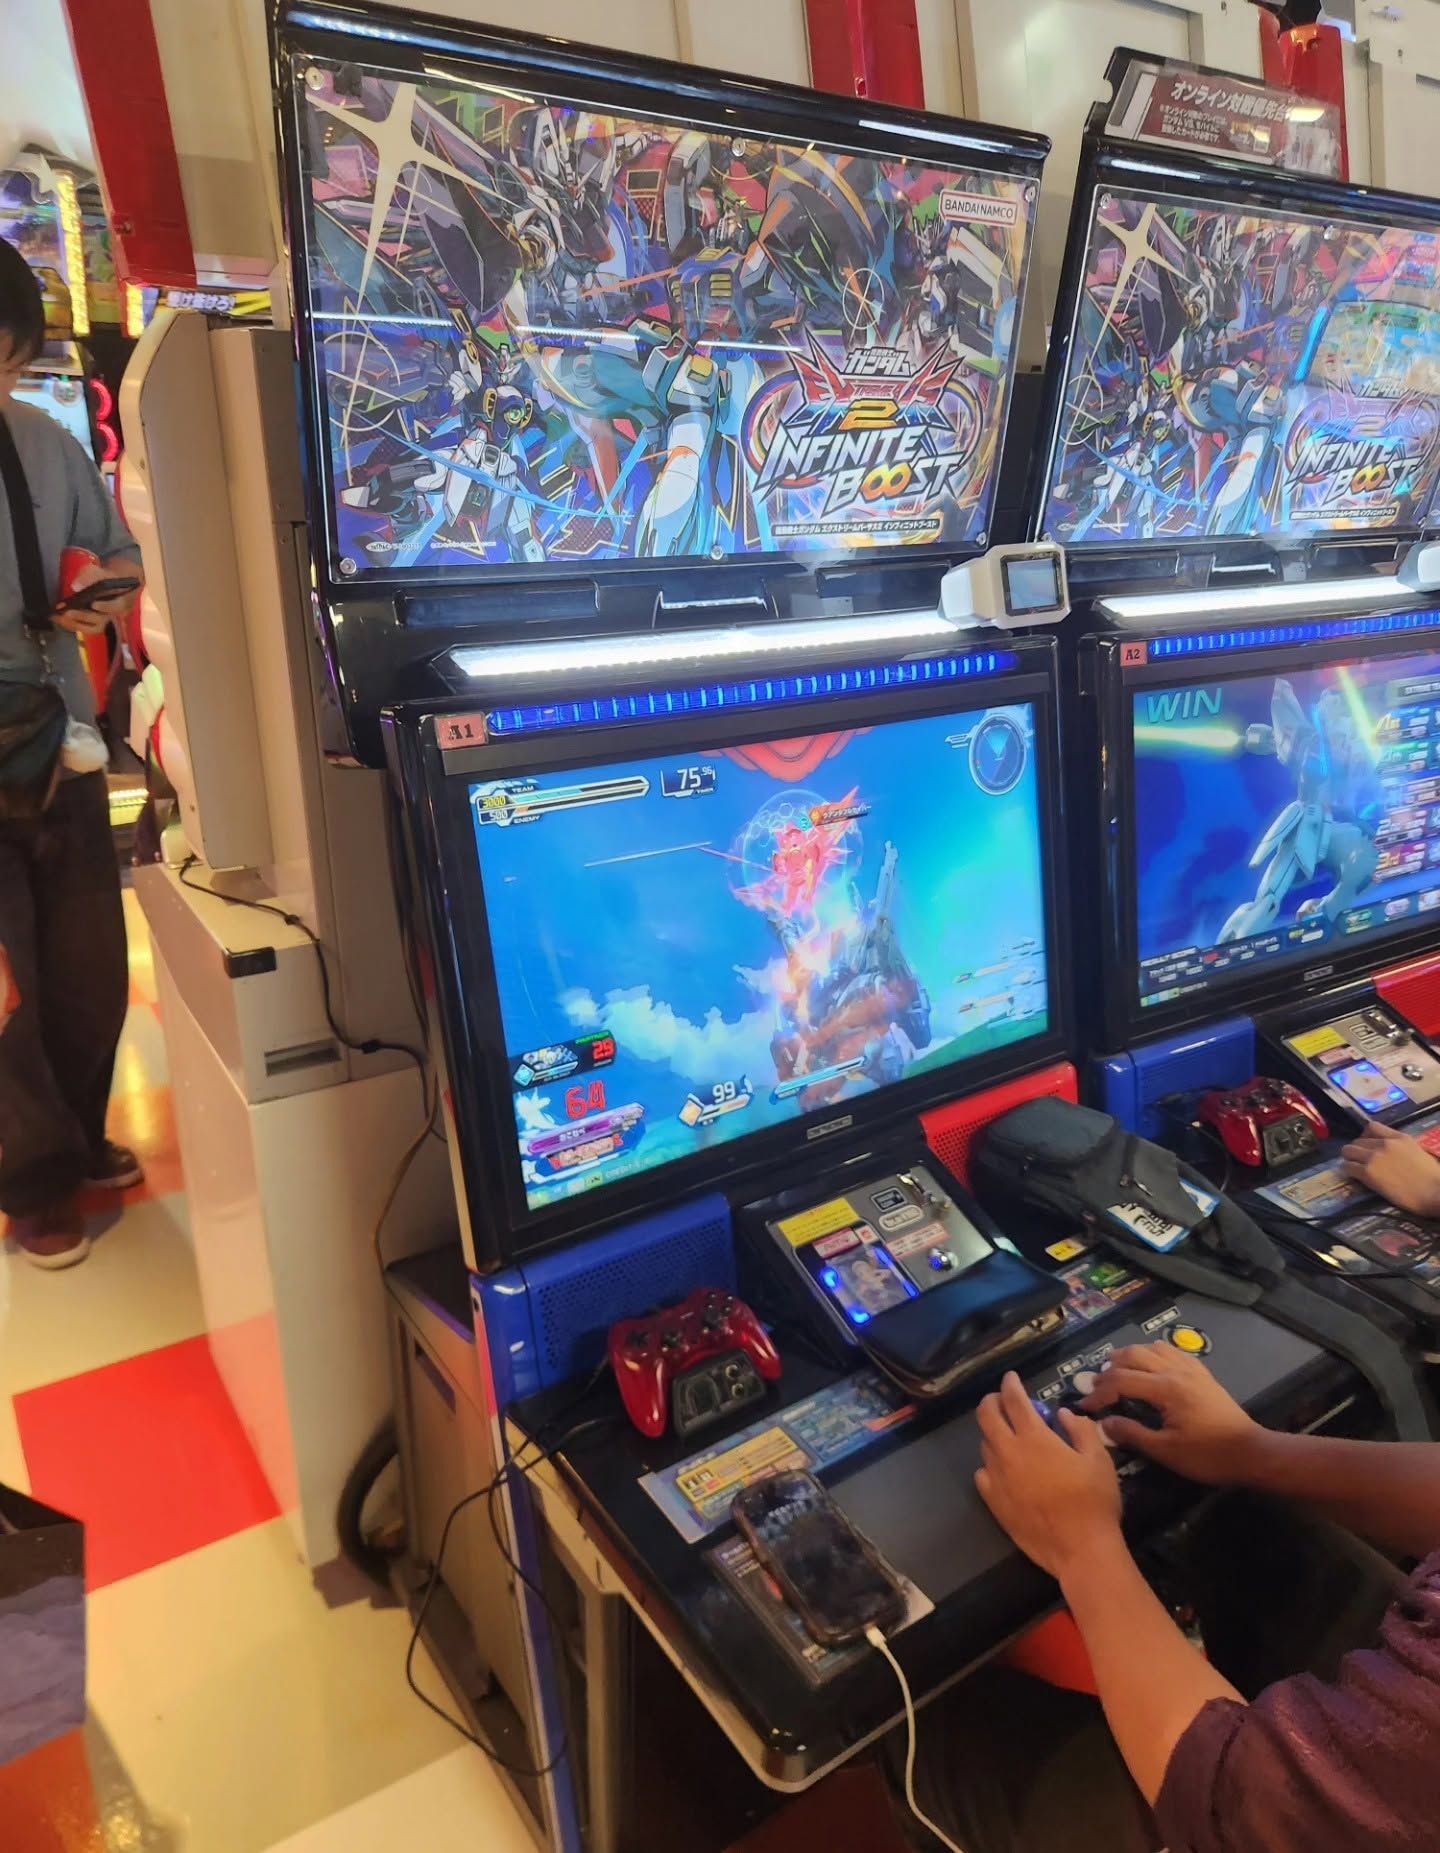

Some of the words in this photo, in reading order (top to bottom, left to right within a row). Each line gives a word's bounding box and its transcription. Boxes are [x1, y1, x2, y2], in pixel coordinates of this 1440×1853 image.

[944, 198, 980, 214] BANDAI
[980, 203, 1014, 219] NAMCO
[839, 399, 900, 431] 2
[753, 420, 929, 503] INFINITE
[1284, 434, 1400, 494] INFINITE
[1125, 648, 1141, 660] A2
[1147, 687, 1222, 723] WIN
[448, 723, 474, 740] A1
[677, 766, 702, 789] 75
[565, 1080, 607, 1119] 64
[712, 1080, 737, 1104] 99
